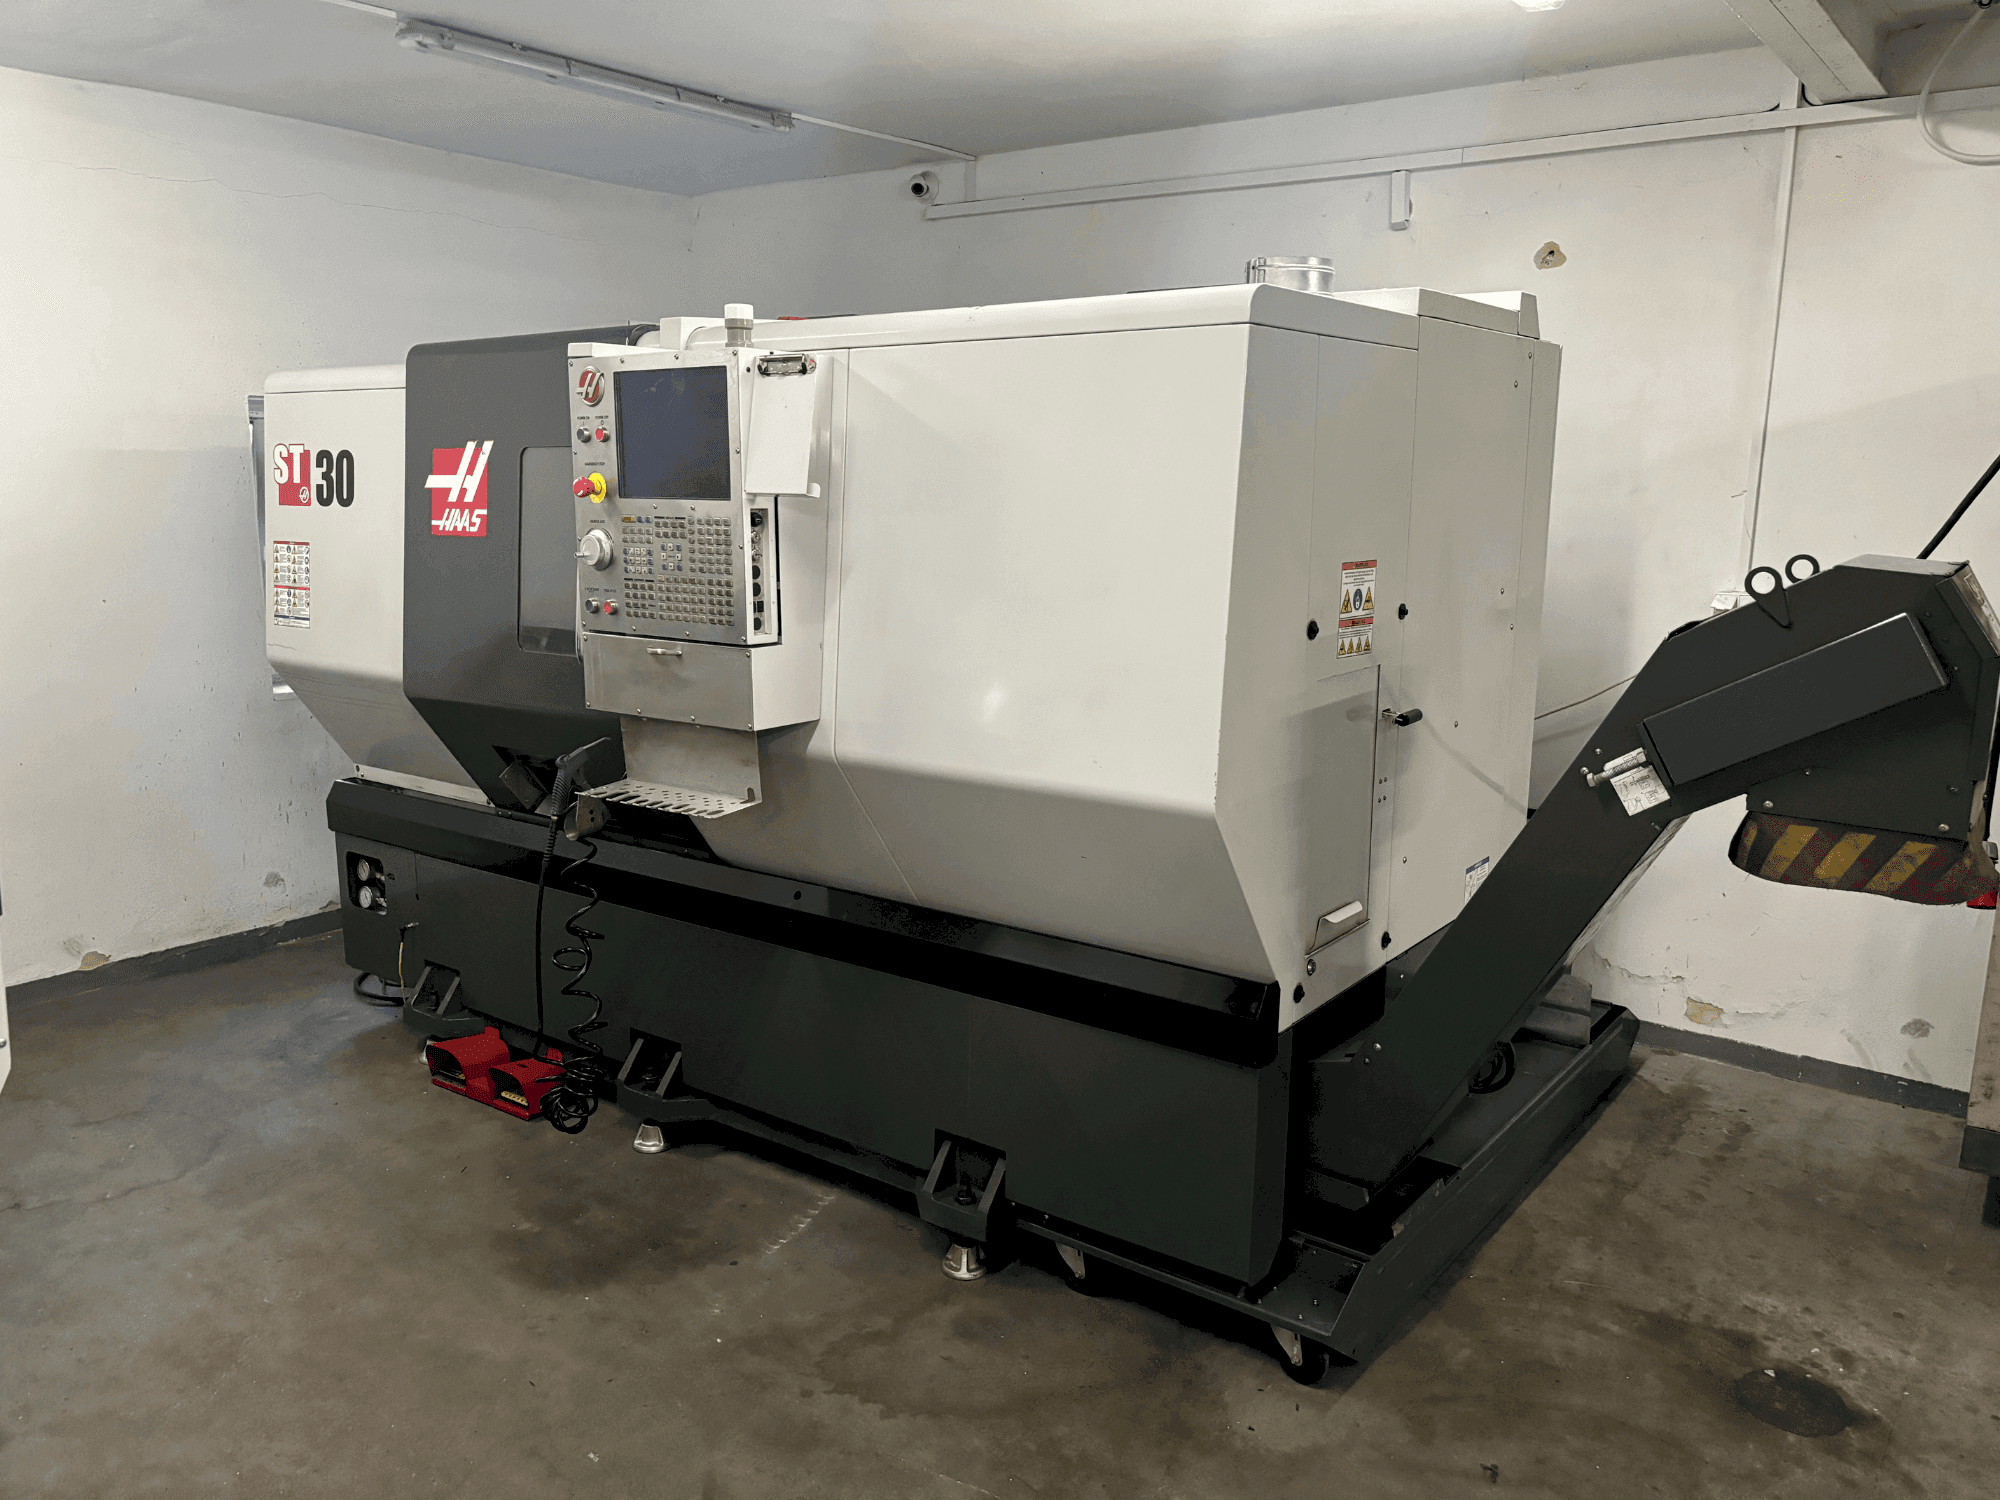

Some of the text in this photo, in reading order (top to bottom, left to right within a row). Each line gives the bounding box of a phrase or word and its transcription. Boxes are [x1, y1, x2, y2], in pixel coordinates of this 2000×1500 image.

[273, 443, 355, 507] ST 30
[431, 508, 487, 532] HAAS
